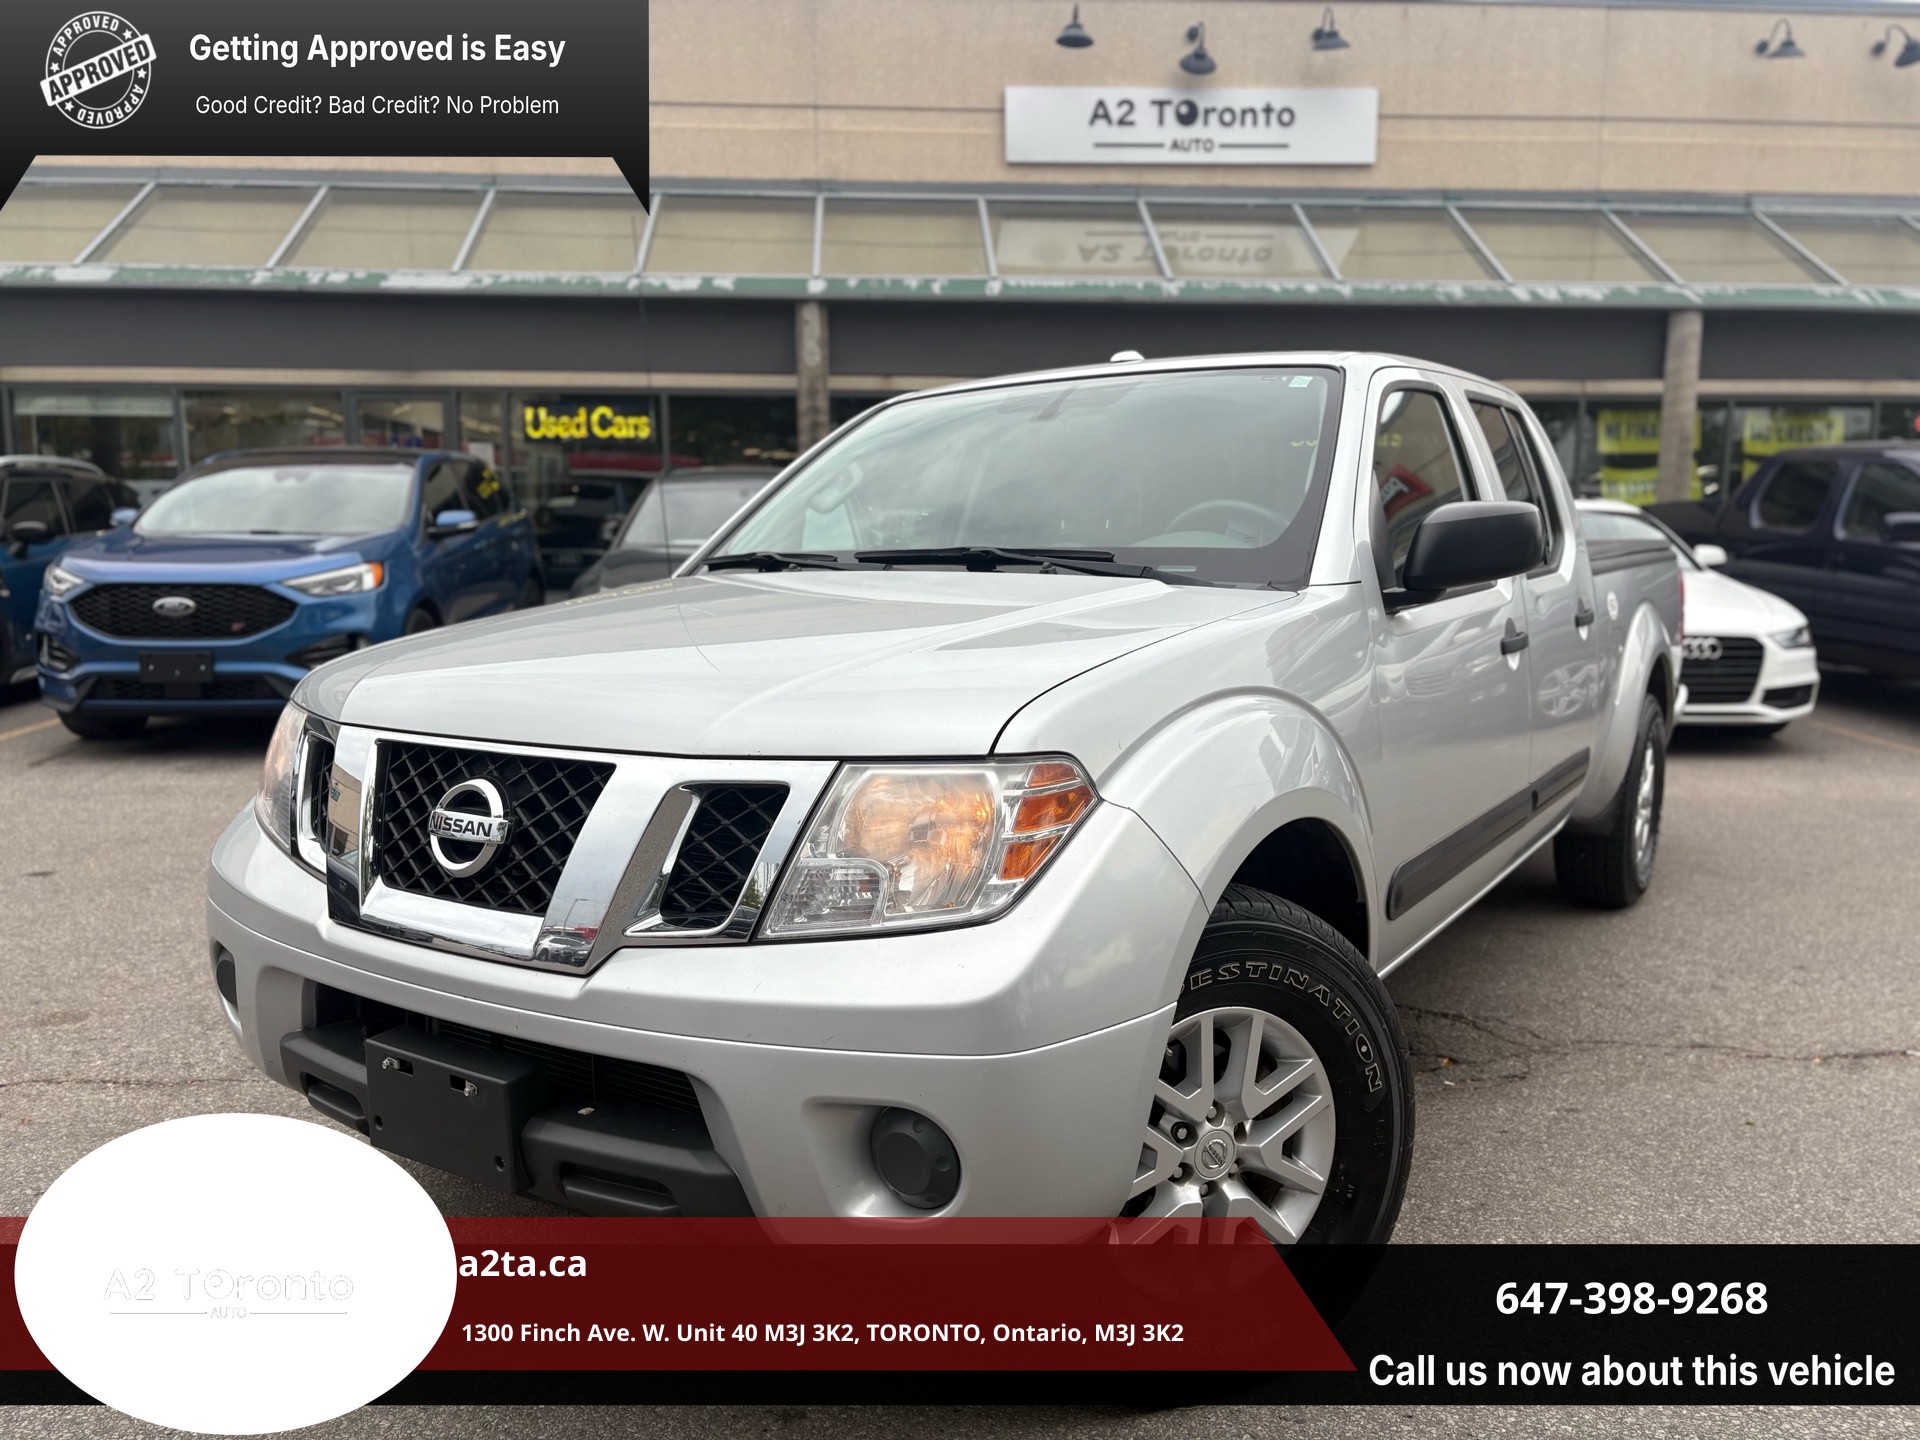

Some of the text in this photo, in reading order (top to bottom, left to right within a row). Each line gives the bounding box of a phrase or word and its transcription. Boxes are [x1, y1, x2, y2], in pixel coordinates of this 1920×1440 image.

[1089, 99, 1135, 126] A2
[1169, 138, 1214, 153] AUTO
[524, 405, 650, 440] Used Cars
[430, 815, 493, 837] NISSAN
[1180, 961, 1383, 1092] ESTINATION
